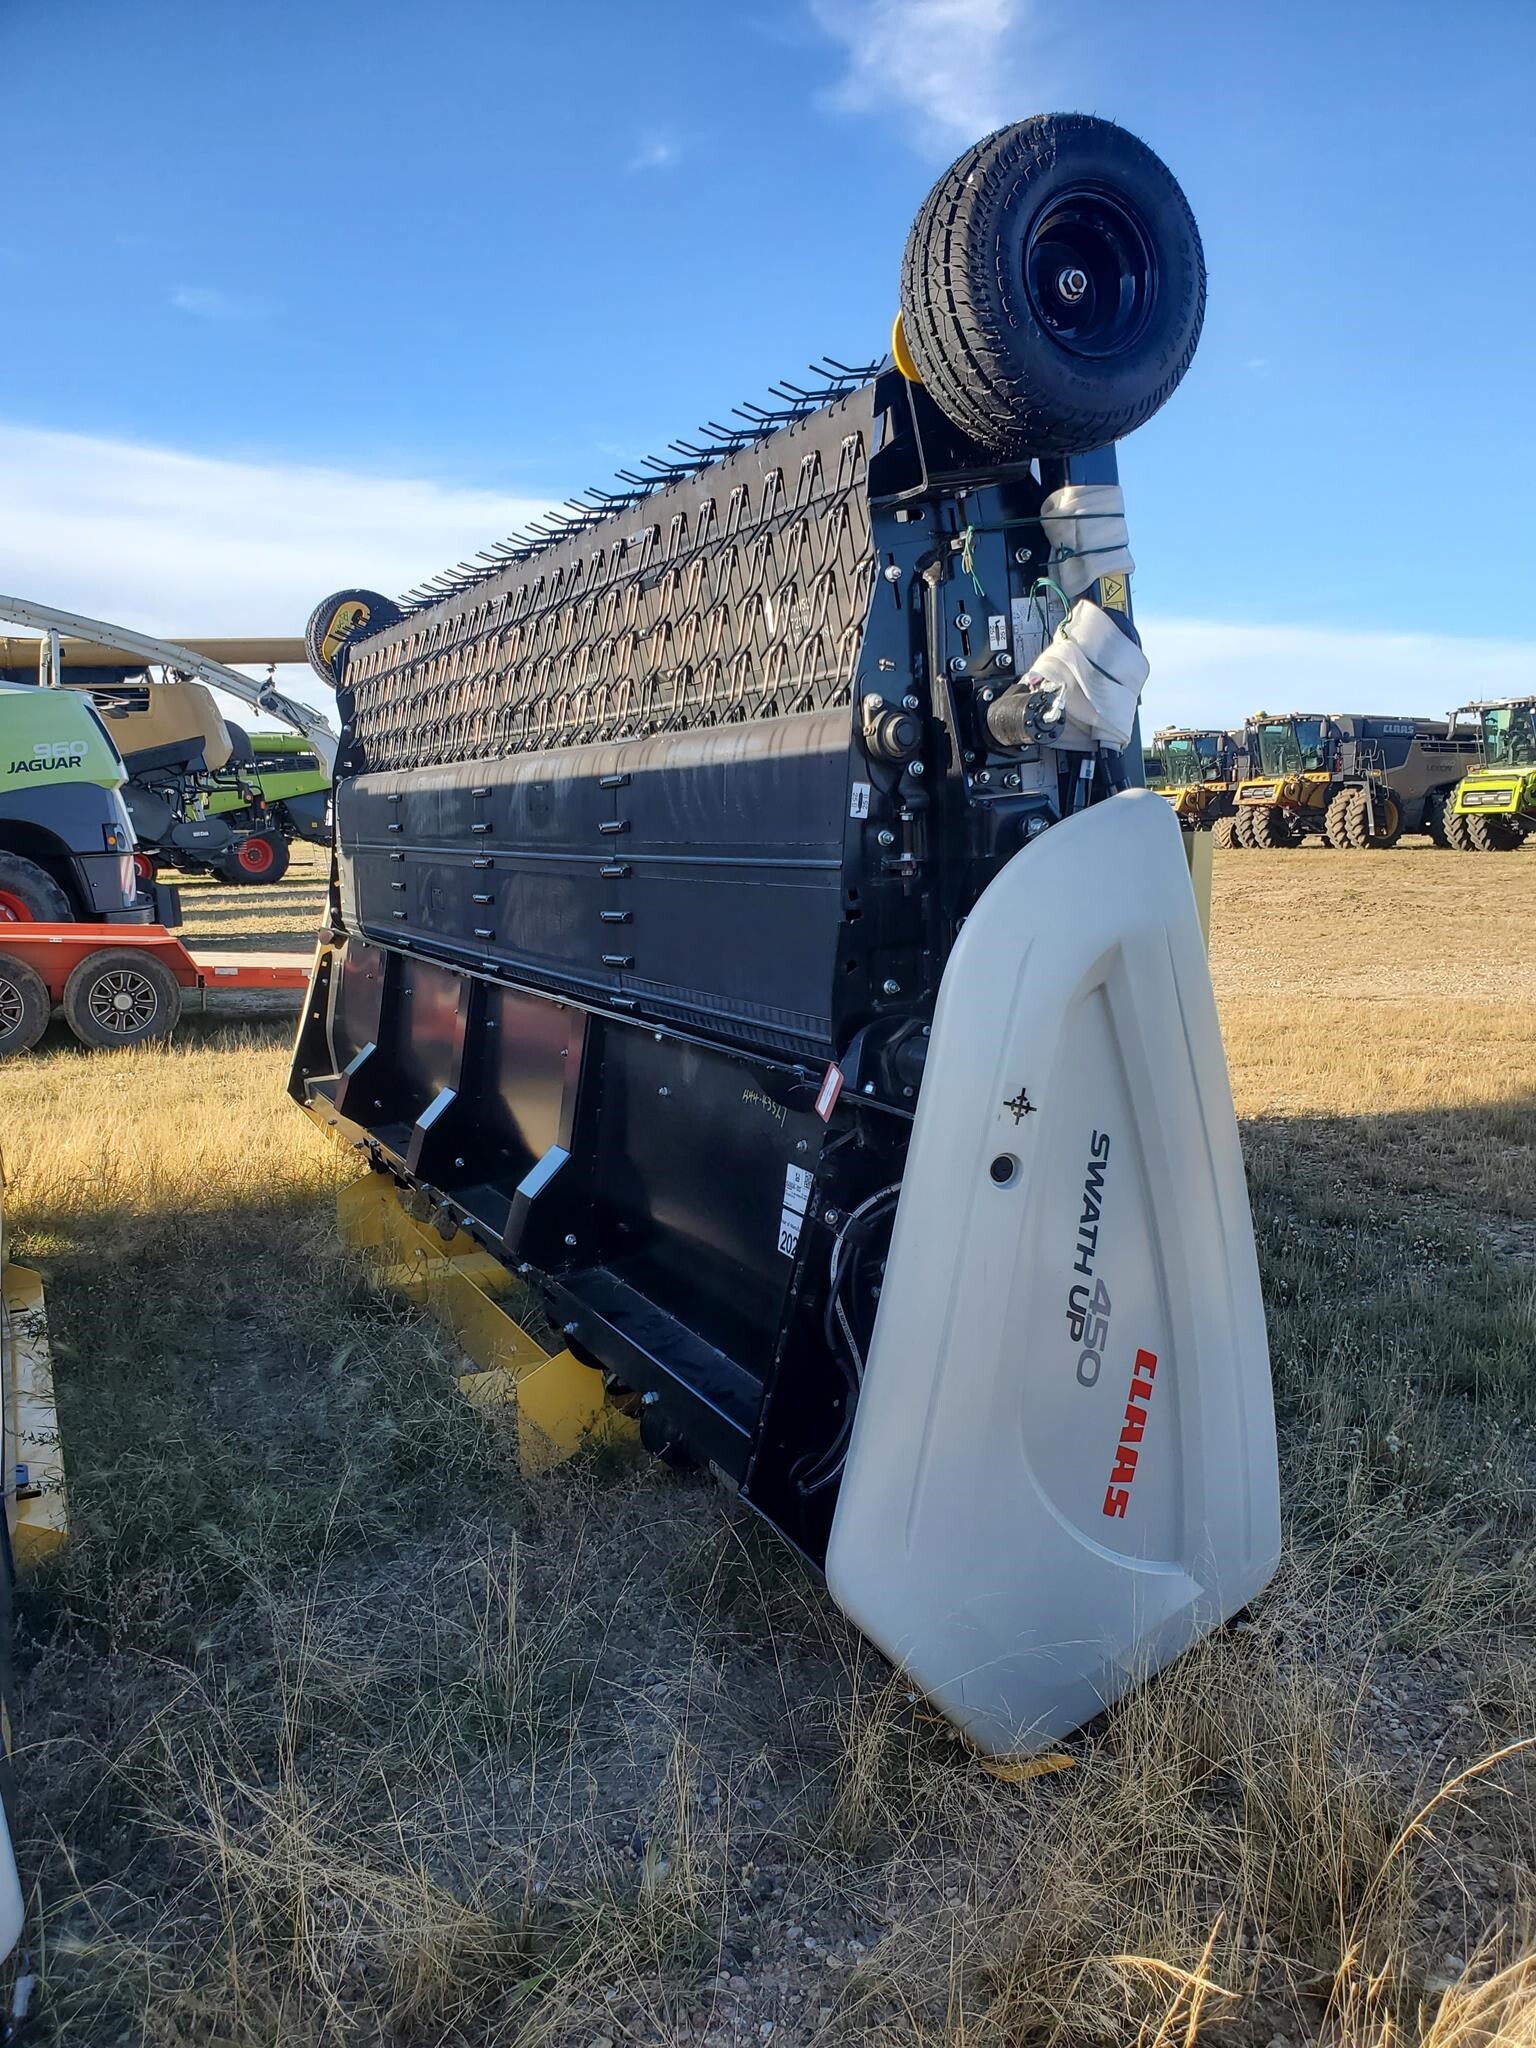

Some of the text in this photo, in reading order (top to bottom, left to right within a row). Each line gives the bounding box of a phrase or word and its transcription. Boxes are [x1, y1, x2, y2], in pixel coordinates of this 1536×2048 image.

[33, 740, 88, 760] 960
[1383, 724, 1415, 734] CLAAS
[7, 756, 81, 774] JAGUAR
[1065, 1129, 1111, 1343] SWATH UP
[1076, 1278, 1112, 1388] 450
[1102, 1348, 1159, 1519] CLAAS
